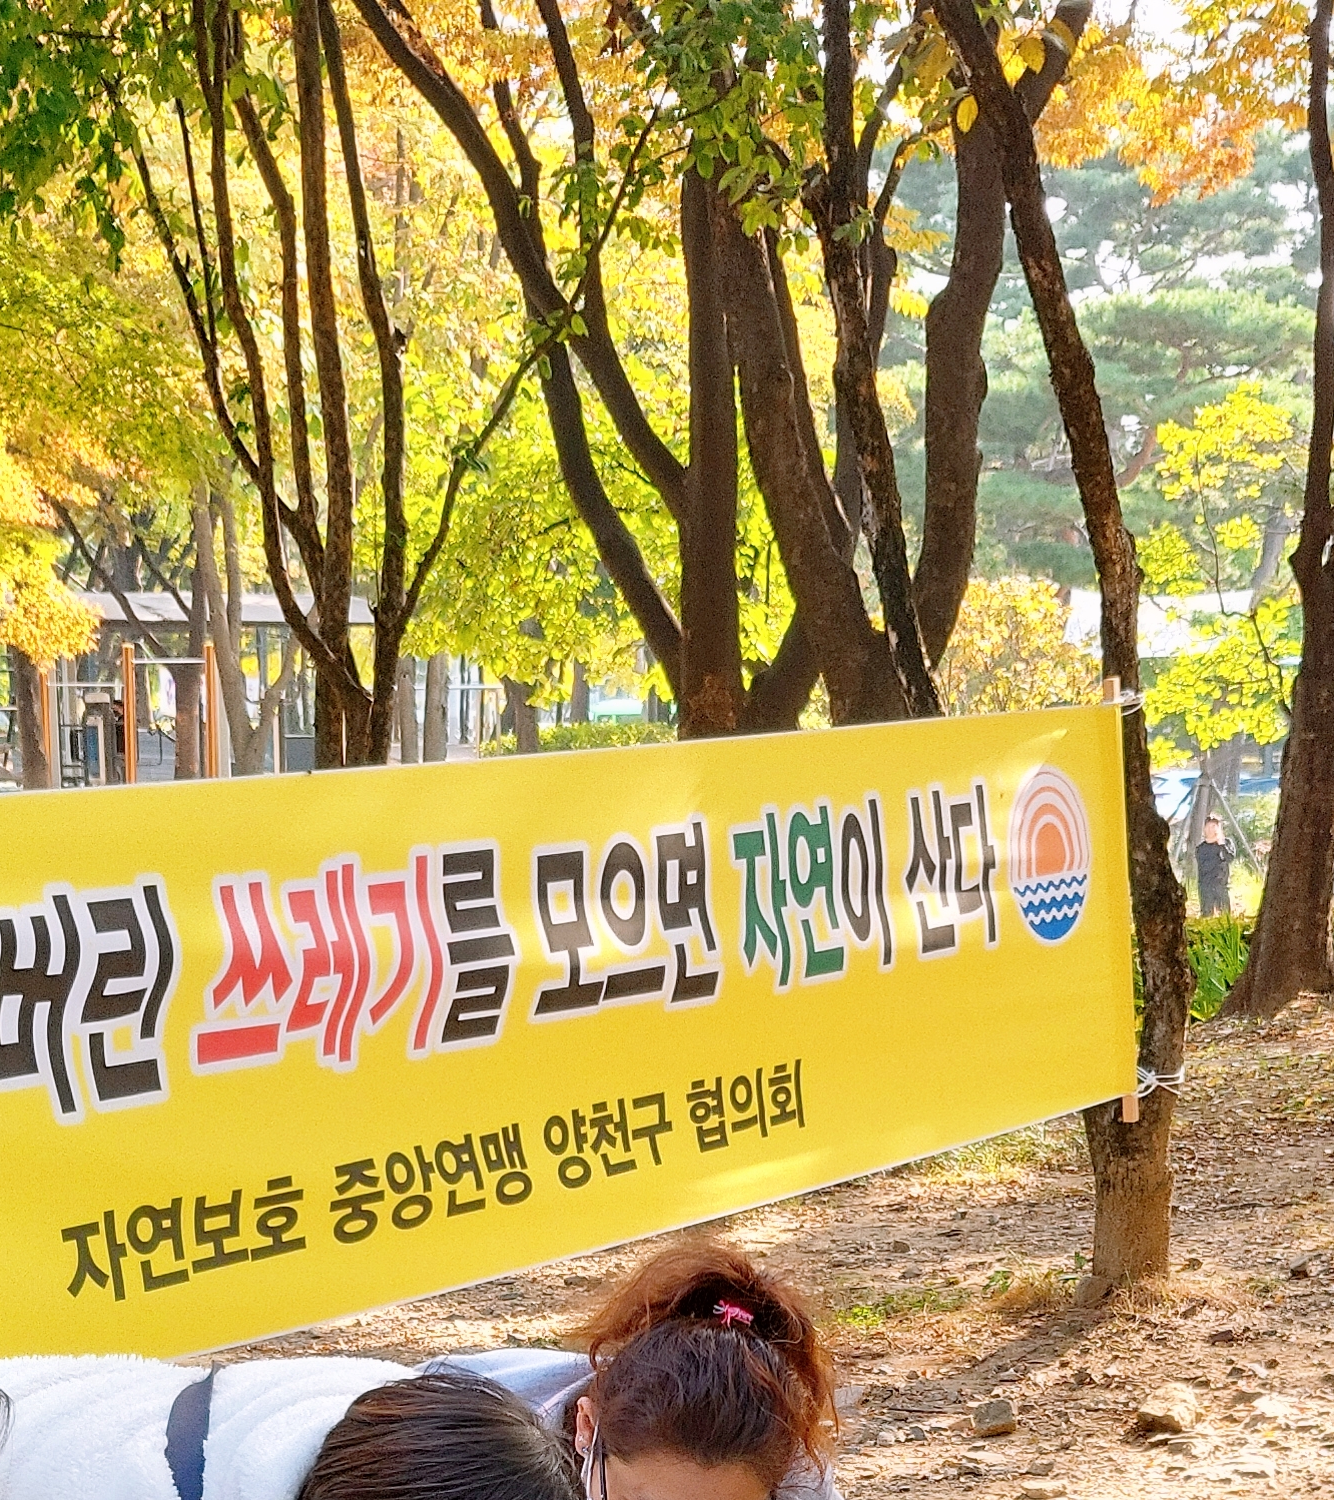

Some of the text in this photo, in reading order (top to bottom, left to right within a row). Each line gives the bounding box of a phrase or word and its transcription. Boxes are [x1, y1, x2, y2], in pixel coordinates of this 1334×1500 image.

[196, 847, 516, 1064] 쓰레기를
[533, 821, 720, 1016] 모으면
[732, 798, 893, 988] 자연이
[904, 784, 997, 955] 산다
[60, 1058, 807, 1303] 자연보호 중앙연맹 양천구 협의회
